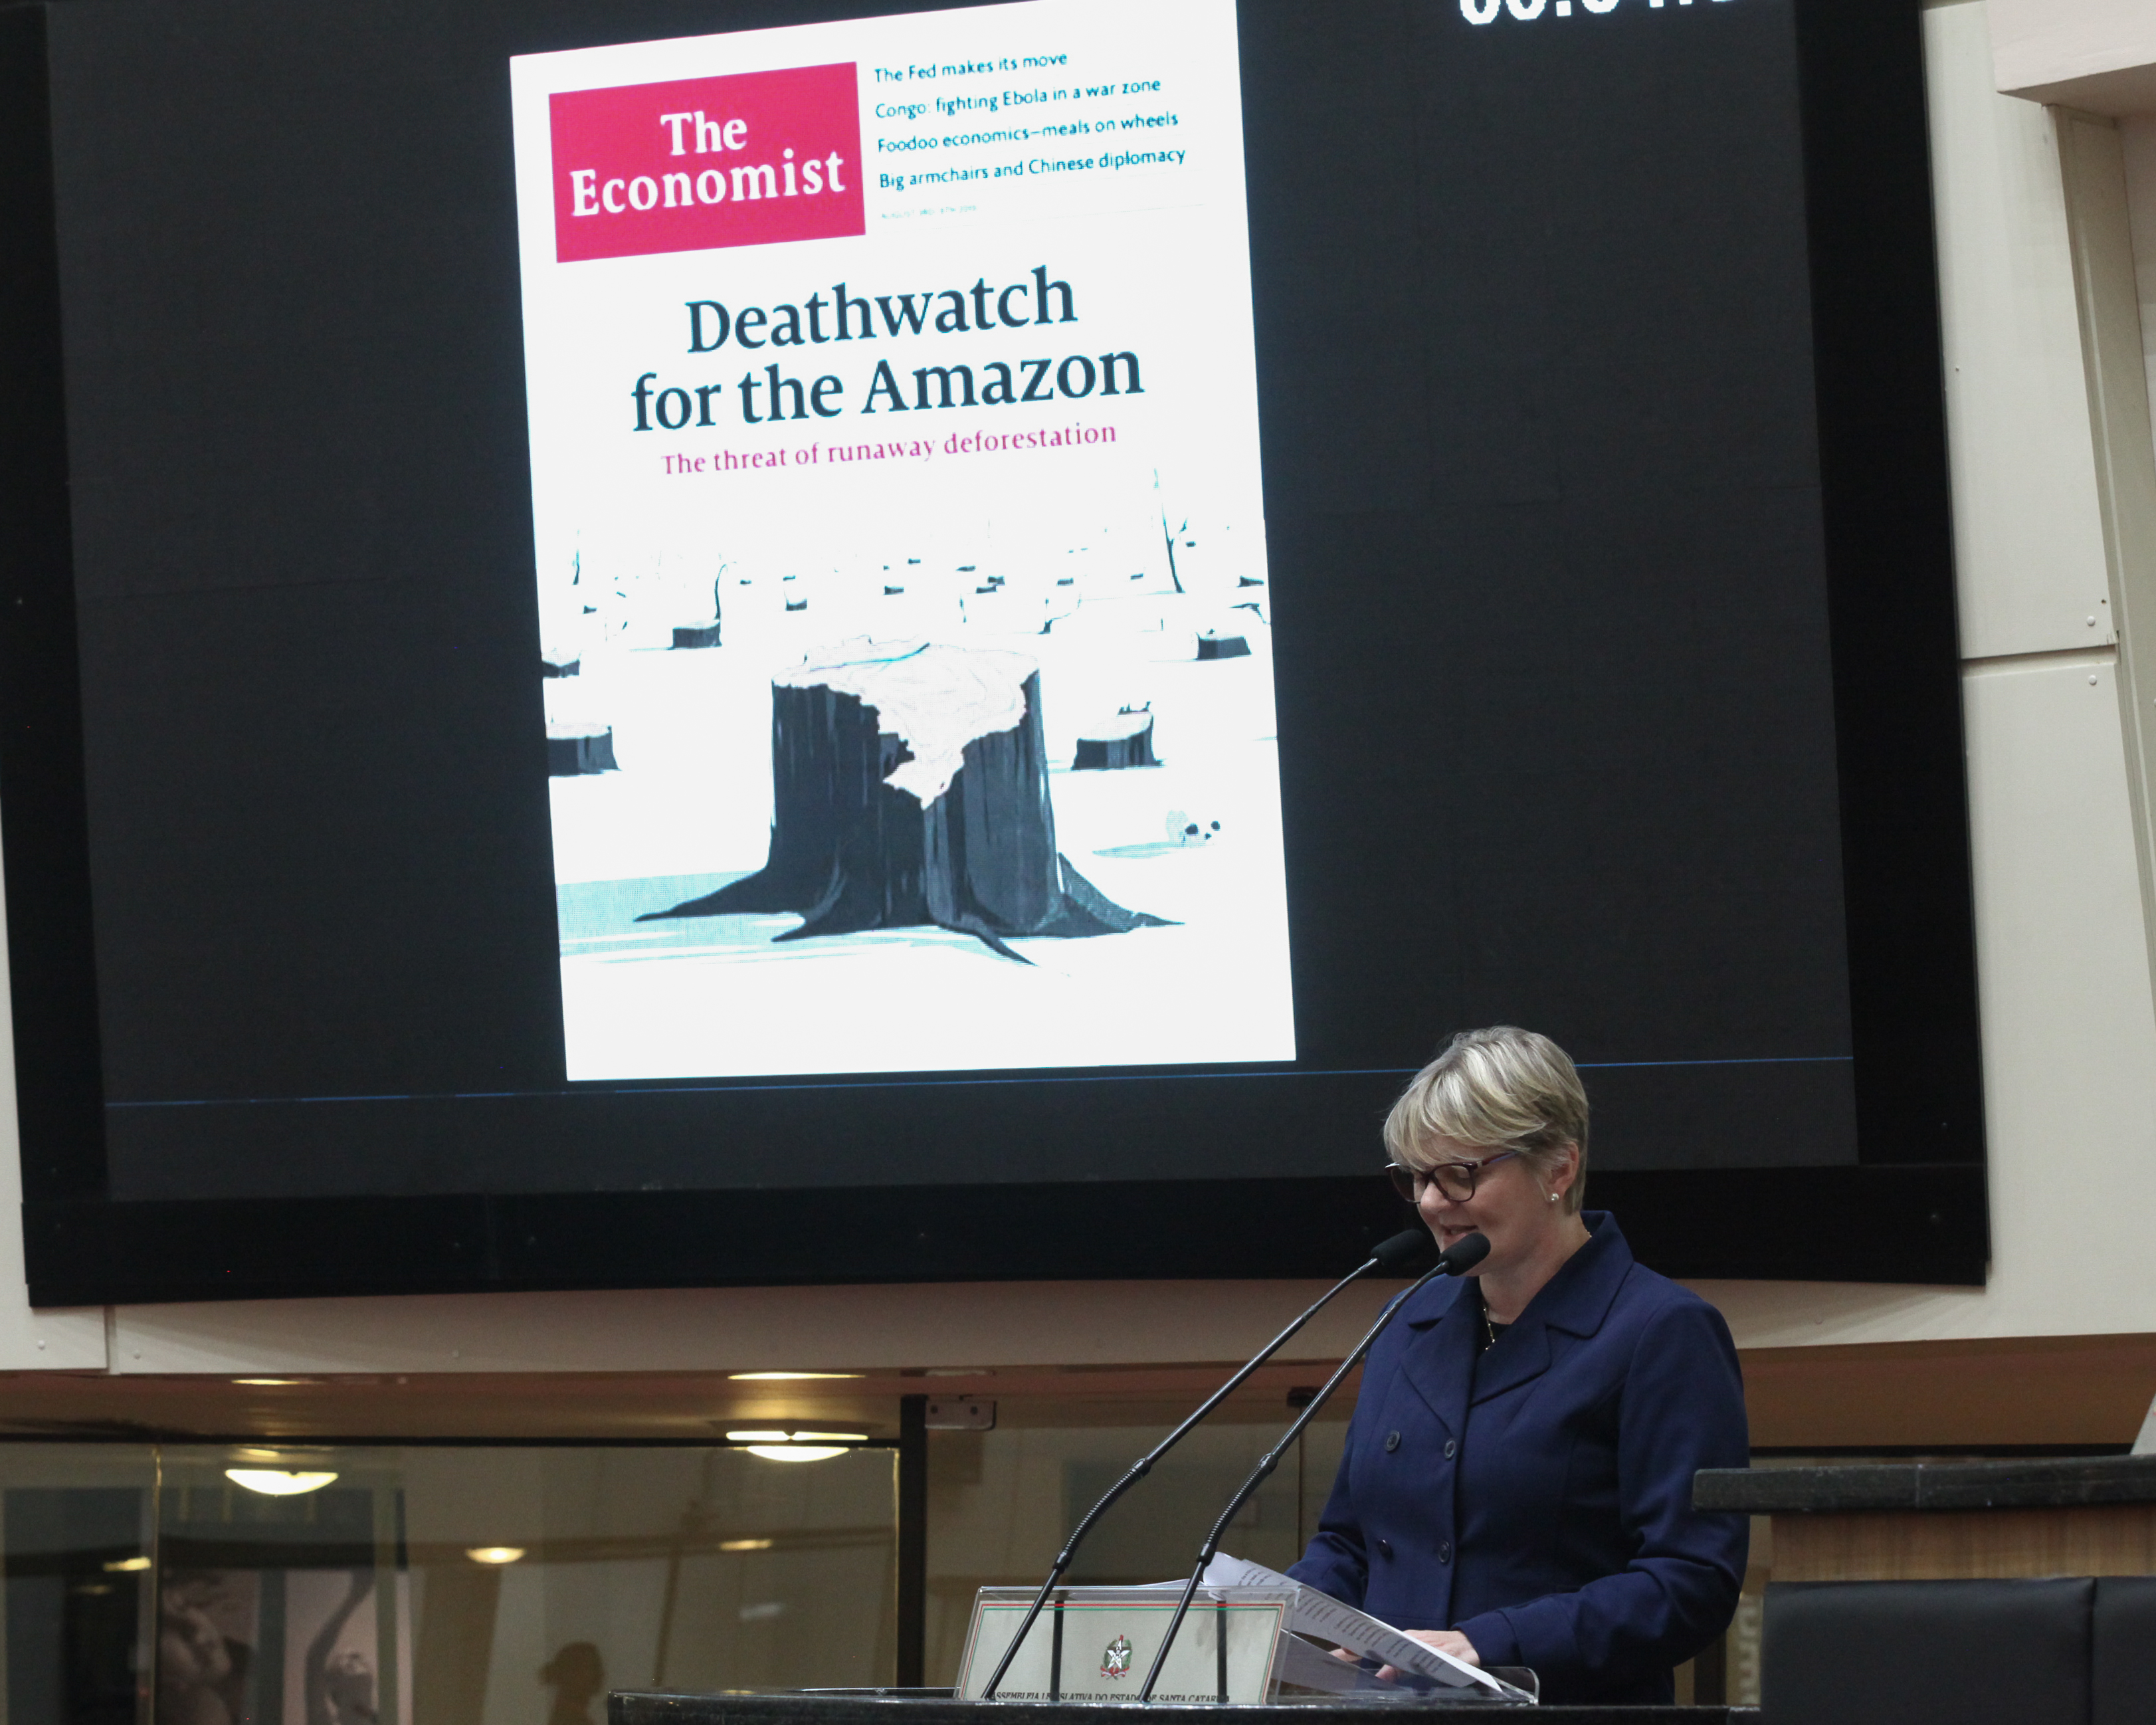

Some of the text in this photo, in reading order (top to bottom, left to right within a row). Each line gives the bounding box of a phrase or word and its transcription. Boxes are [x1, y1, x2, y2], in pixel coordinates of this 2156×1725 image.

[874, 53, 1067, 82] The Fed makes its move
[936, 95, 999, 115] fighting
[1003, 88, 1047, 106] Ebola
[1053, 87, 1067, 100] in
[1073, 88, 1080, 99] a
[1086, 84, 1116, 97] war
[1122, 79, 1161, 94] zone
[660, 111, 747, 155] The
[878, 136, 937, 153] Foodoo
[1095, 120, 1116, 132] on
[1120, 111, 1178, 130] wheels
[570, 148, 844, 216] Economist
[880, 150, 1185, 191] Big armchairs and Chinese diplomacy
[684, 265, 1078, 354] Deathwatch
[631, 352, 1145, 431] for the Amazon
[662, 423, 1116, 474] The threat of runaway deforestation
[1041, 1692, 1092, 1700] LESLATIVA
